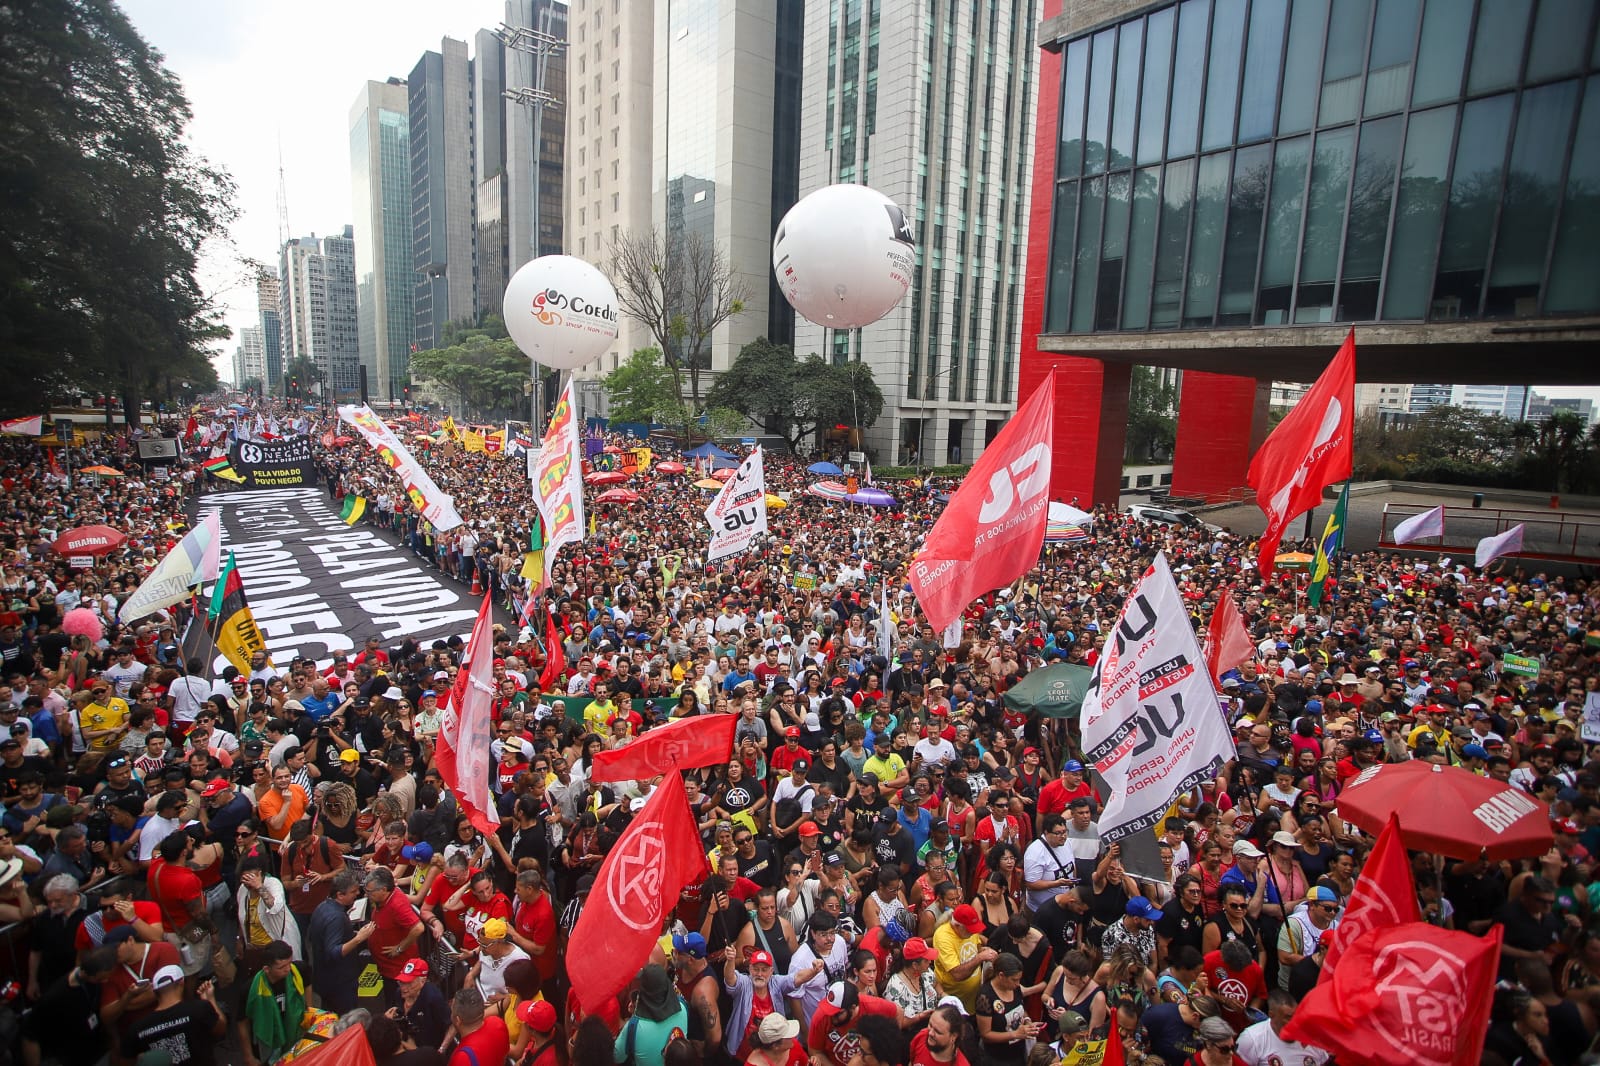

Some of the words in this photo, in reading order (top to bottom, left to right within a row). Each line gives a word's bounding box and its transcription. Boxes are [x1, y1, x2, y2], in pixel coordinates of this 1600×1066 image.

[264, 446, 310, 459] NEGRA
[277, 476, 302, 484] NEGRO
[68, 537, 108, 549] BRAHMA
[301, 531, 408, 575] PELA
[339, 567, 480, 640] VIDA
